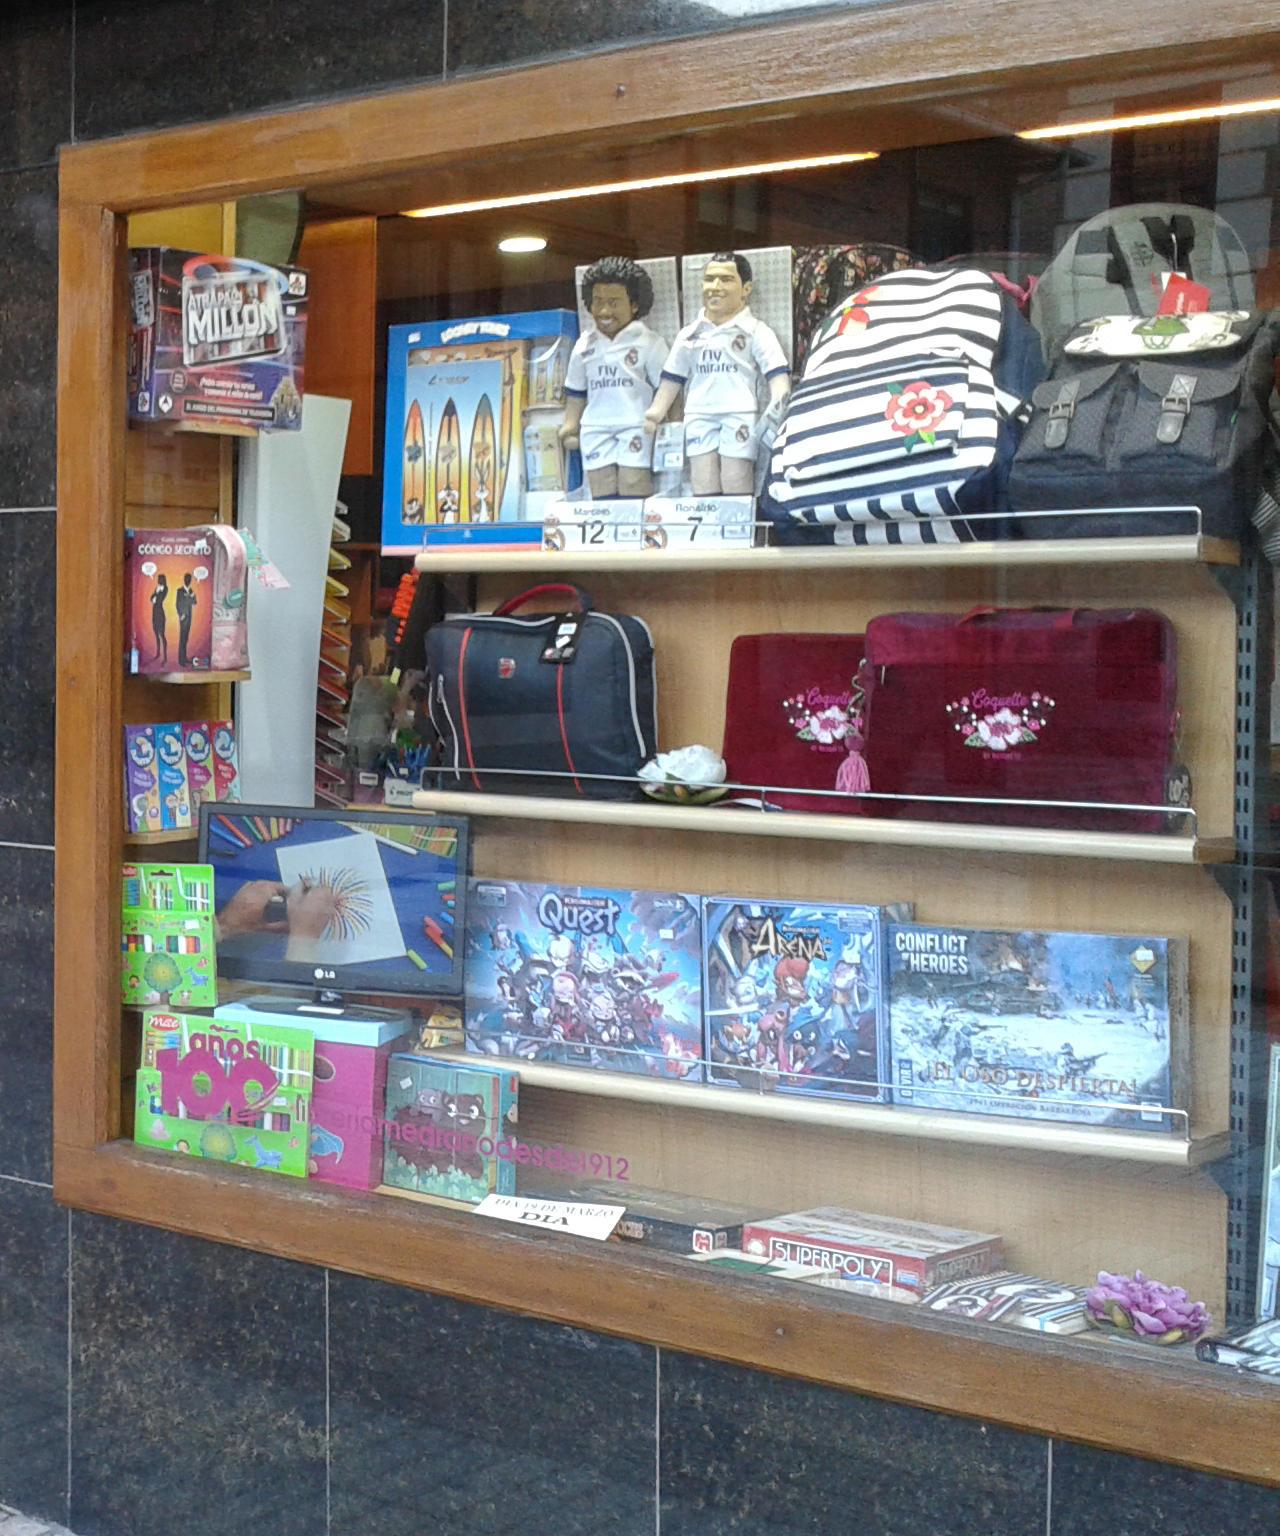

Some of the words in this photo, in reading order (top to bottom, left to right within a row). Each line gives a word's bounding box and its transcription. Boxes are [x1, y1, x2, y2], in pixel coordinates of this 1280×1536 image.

[189, 296, 279, 345] MILLÓN
[702, 349, 721, 361] Fly
[598, 365, 617, 378] Fly
[578, 520, 605, 545] 12
[688, 516, 704, 542] 7
[138, 542, 172, 555] CÓDIGO
[971, 687, 1028, 709] Coquette
[538, 891, 621, 936] Quest
[895, 932, 969, 954] CONFLICT
[910, 953, 969, 976] HEROES
[899, 1060, 913, 1098] DVIR
[565, 1205, 615, 1217] MARZO
[775, 1242, 884, 1279] SUPERPOLY
